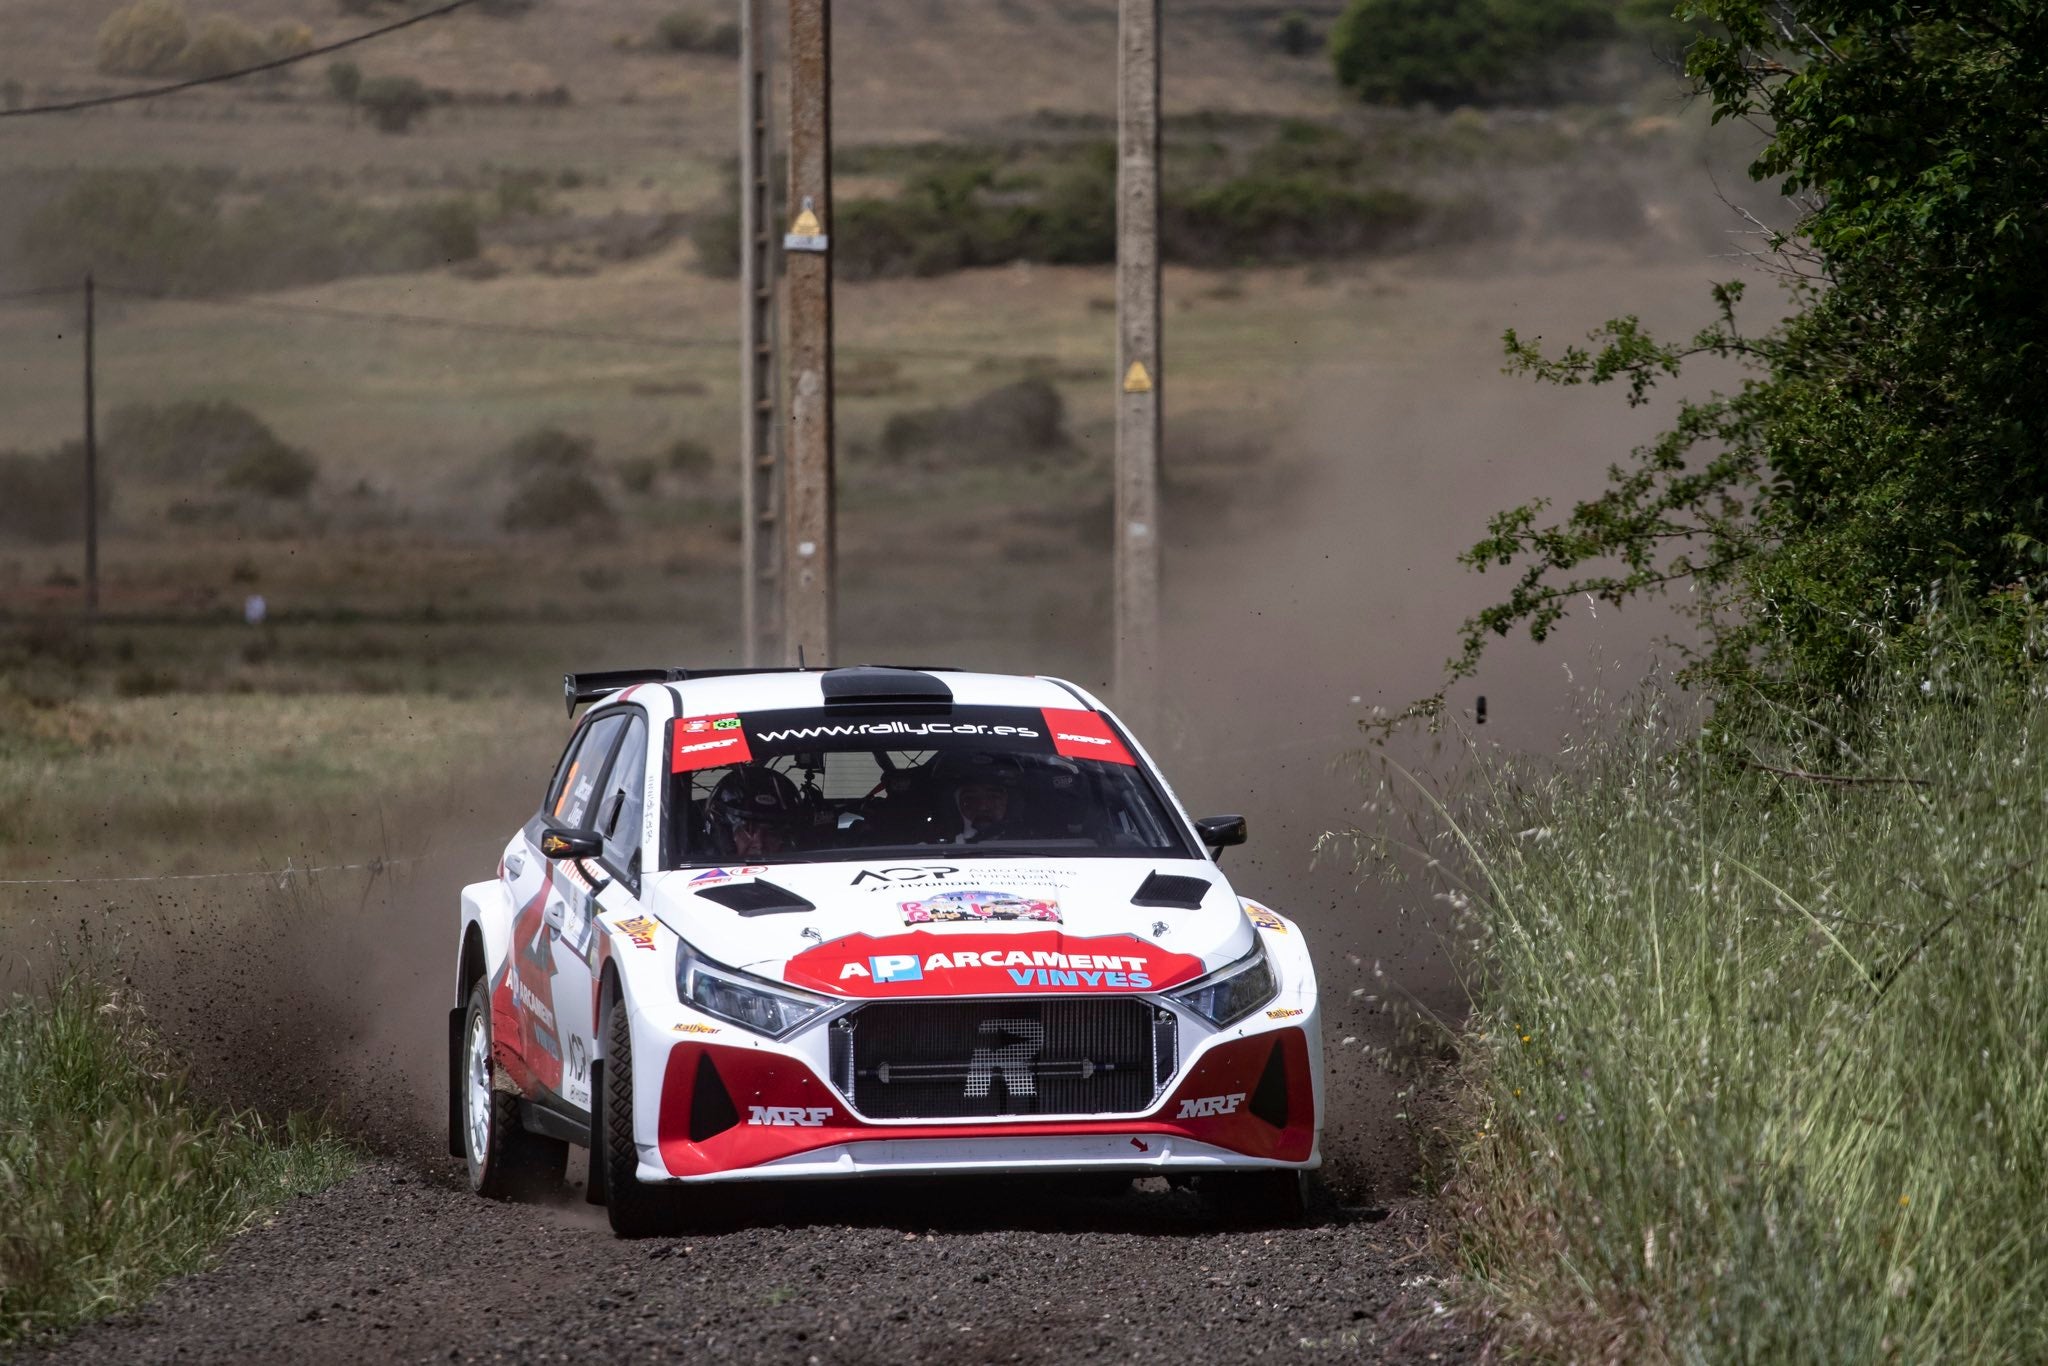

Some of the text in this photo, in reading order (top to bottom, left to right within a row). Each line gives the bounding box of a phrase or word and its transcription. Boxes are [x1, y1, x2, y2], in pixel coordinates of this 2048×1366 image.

[757, 721, 1039, 742] www.rallycar.es
[1007, 969, 1153, 988] VINYES
[674, 1022, 723, 1035] Rallycar
[963, 1018, 1044, 1098] R
[748, 1105, 834, 1127] MRF
[1176, 1092, 1246, 1119] MRF
